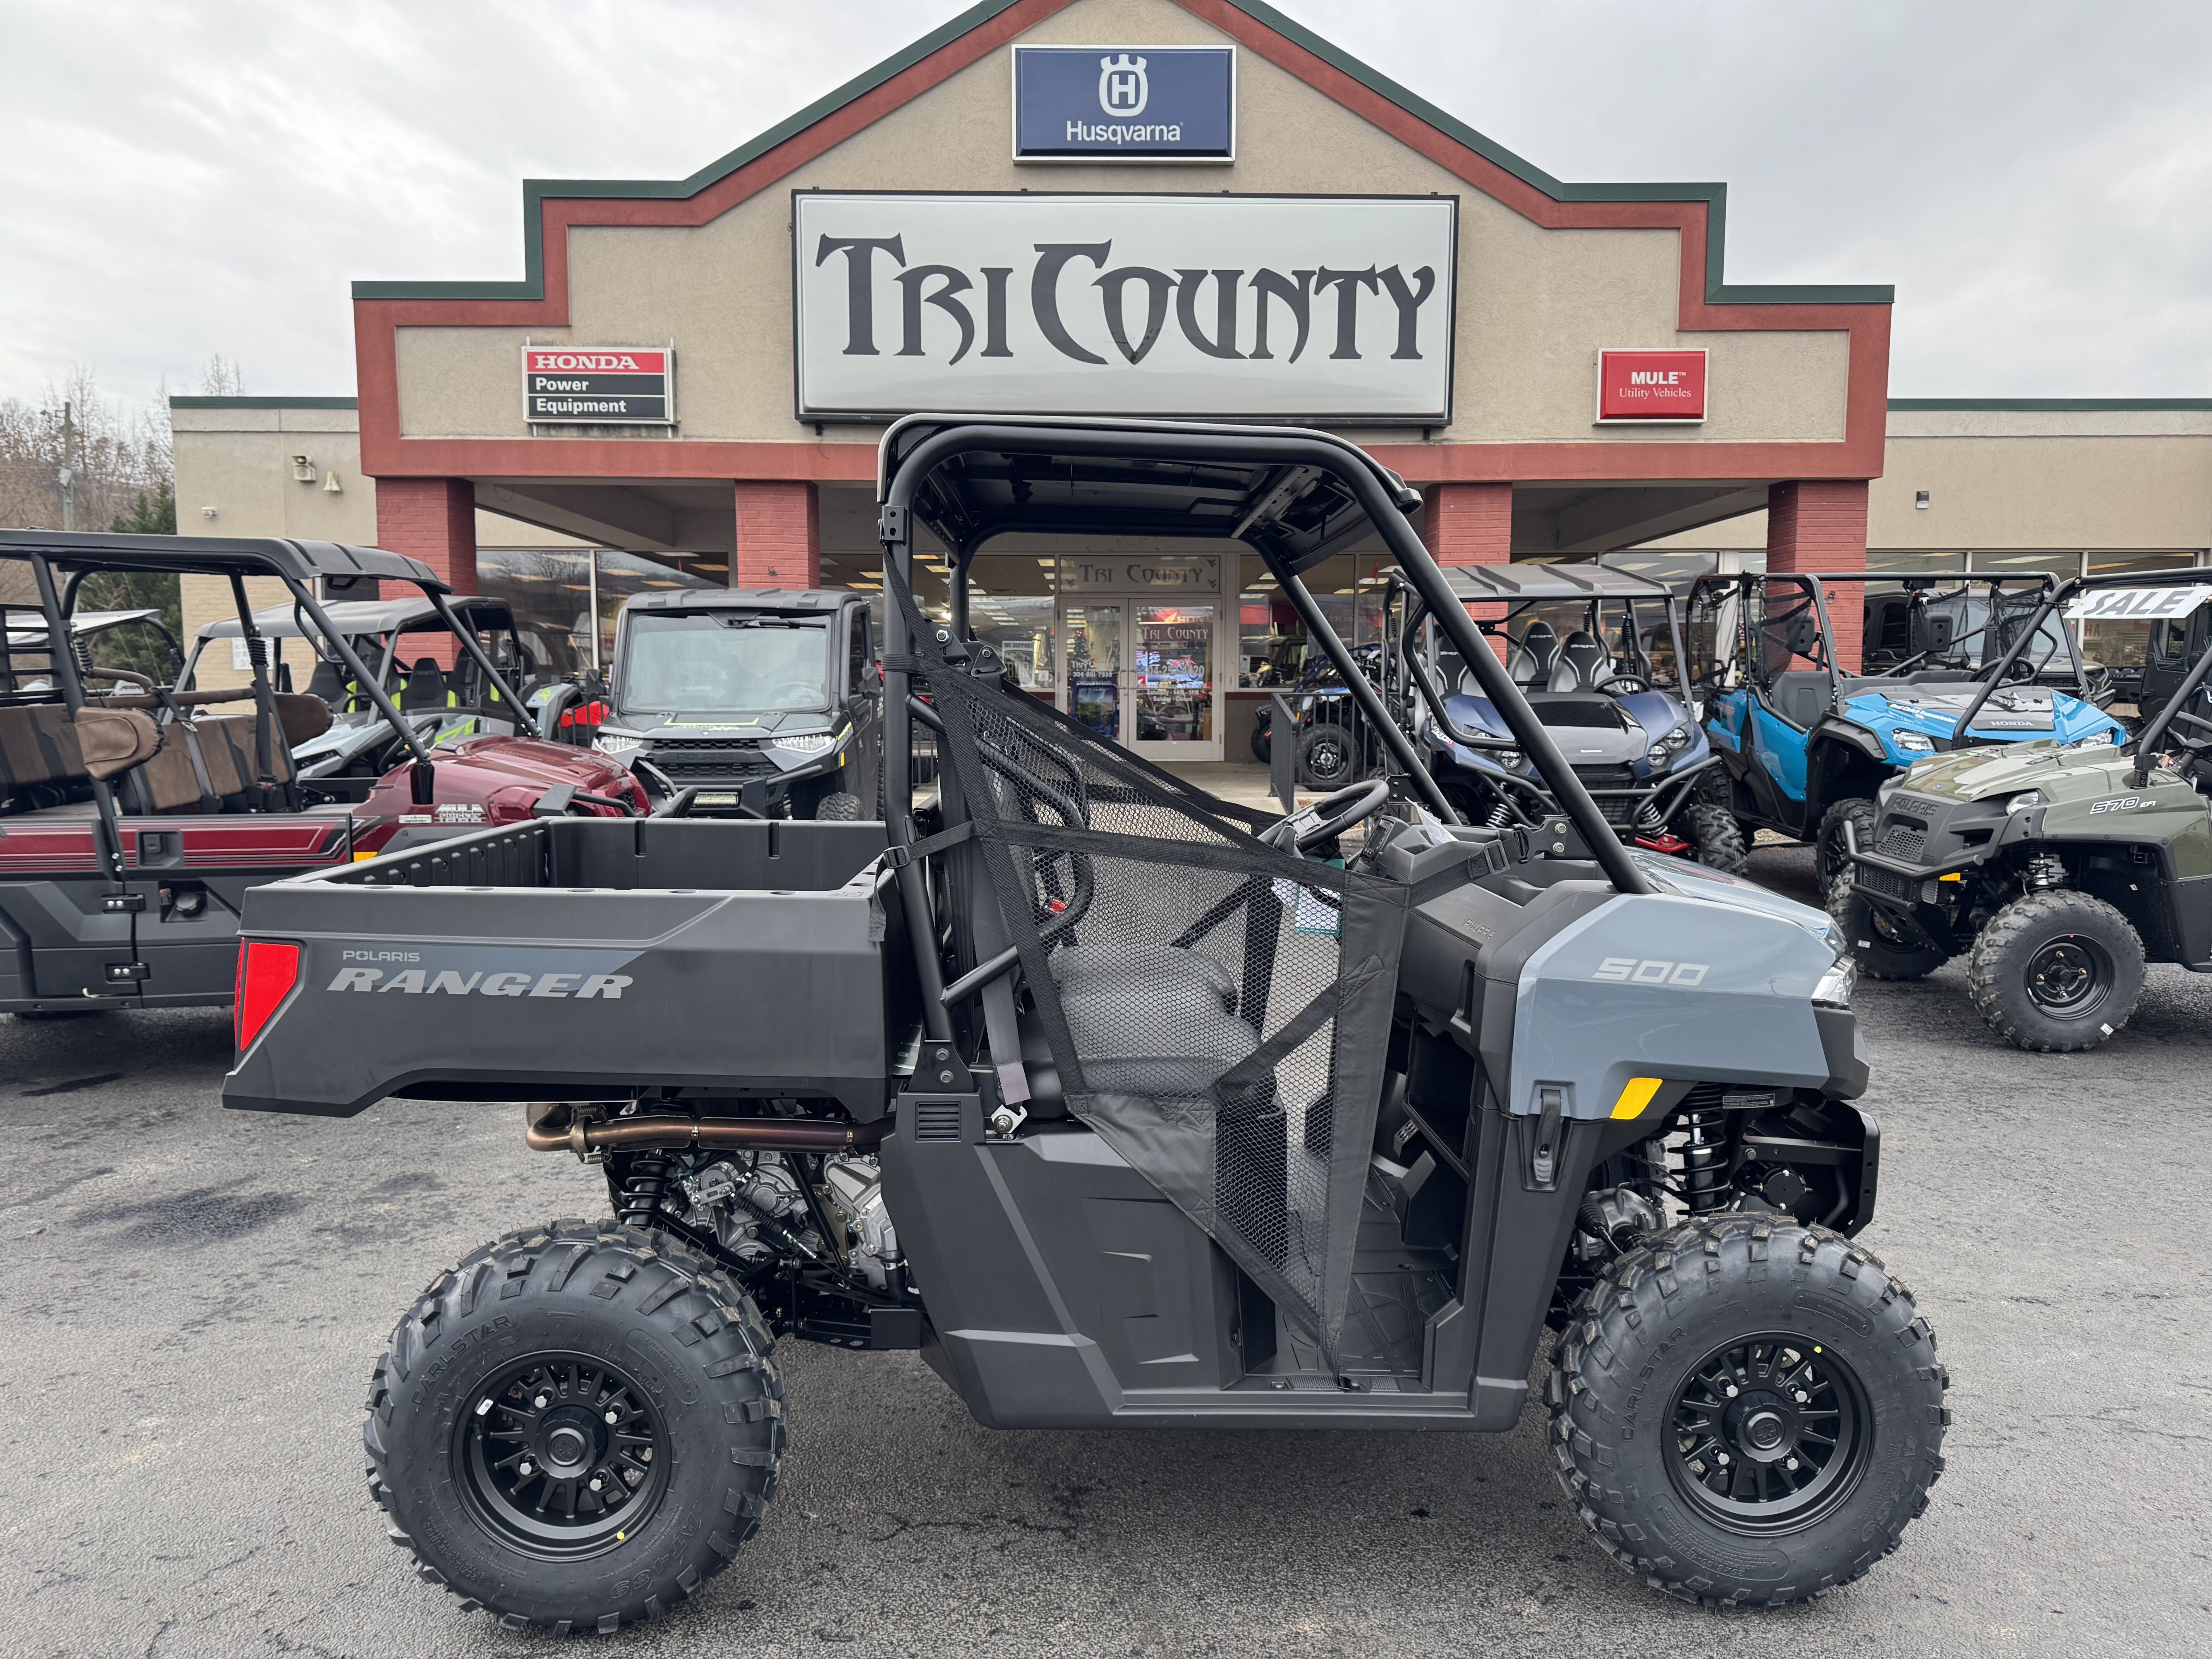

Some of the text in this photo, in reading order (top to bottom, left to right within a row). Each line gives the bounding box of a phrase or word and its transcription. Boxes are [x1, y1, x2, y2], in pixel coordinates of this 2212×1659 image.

[1066, 120, 1181, 145] Husqvarna
[535, 355, 640, 369] HONDA
[535, 377, 589, 391] Power
[1619, 388, 1692, 400] Utility Vehicles
[536, 398, 627, 415] Equipment
[2083, 590, 2195, 616] SALE
[1891, 797, 1940, 817] POLARIS
[2090, 796, 2140, 814] 570
[1462, 918, 1496, 940] POLARIS
[342, 950, 420, 962] POLARIS
[1592, 957, 1710, 986] 500
[326, 967, 634, 999] RANGER
[410, 1315, 512, 1407] CARLSTAR
[1621, 1326, 1688, 1442] CARLSTAR
[610, 1511, 699, 1599] AT489
